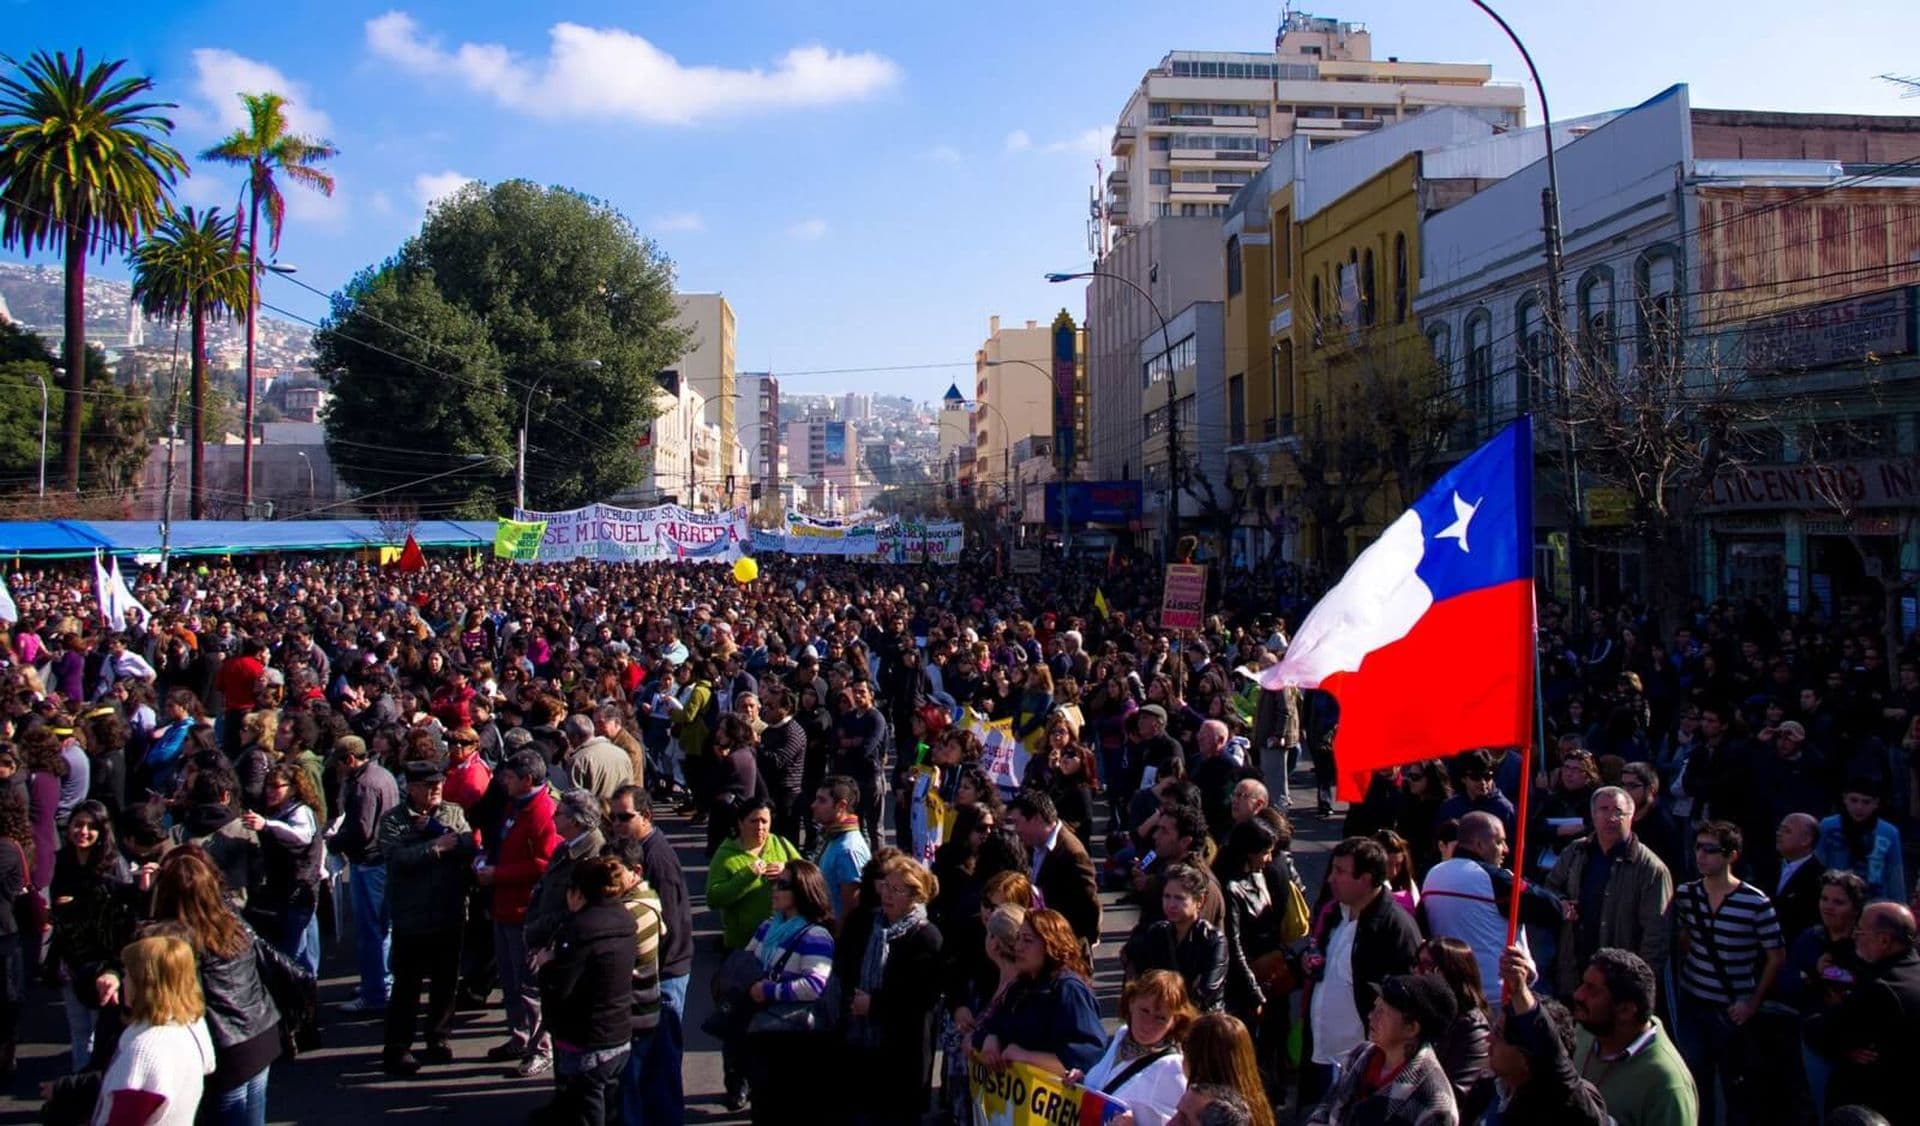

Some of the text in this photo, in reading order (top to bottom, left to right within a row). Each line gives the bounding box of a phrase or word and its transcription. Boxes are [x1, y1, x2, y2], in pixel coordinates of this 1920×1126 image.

[1699, 464, 1866, 505] LTICENTRO
[576, 509, 589, 521] AL
[594, 506, 632, 522] PUEBLO
[637, 509, 656, 522] QUE
[541, 526, 569, 545] SE
[576, 521, 649, 544] MIGUEL
[654, 521, 739, 544] CARRERA
[926, 527, 962, 539] DUCACION
[972, 1063, 1026, 1105] COSEJO
